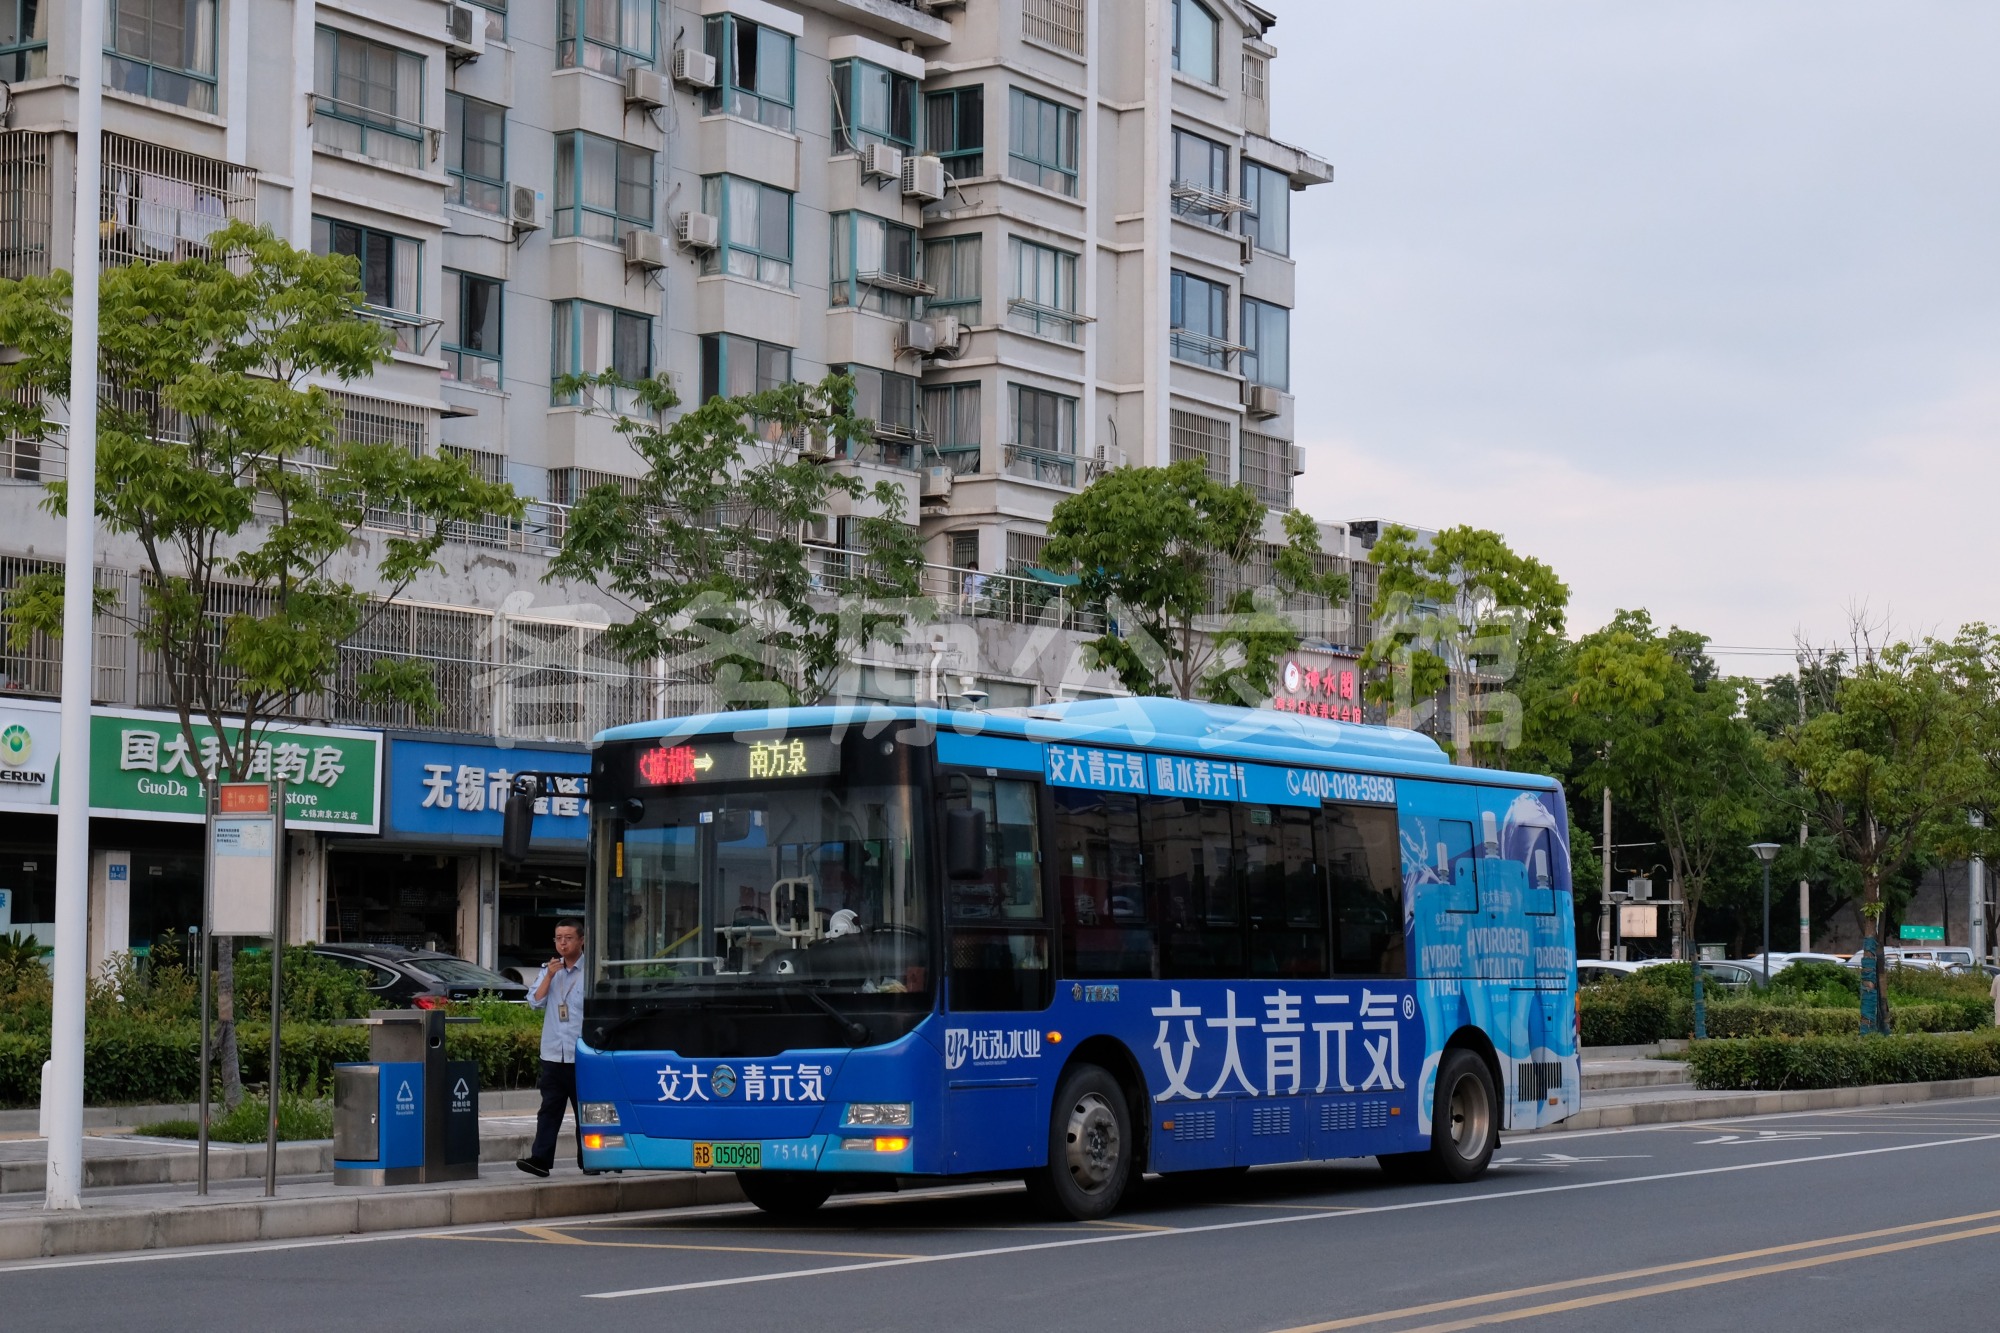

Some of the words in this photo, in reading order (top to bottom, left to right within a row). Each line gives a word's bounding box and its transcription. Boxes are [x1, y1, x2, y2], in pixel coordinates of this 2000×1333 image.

[121, 729, 345, 787] 国大和润药房
[749, 738, 807, 778] 南方泉
[138, 778, 188, 797] GuoDa
[1156, 757, 1247, 798] 喝水养元气
[1302, 771, 1395, 803] 400-018-5958
[1467, 927, 1529, 958] HYDROGEN
[1475, 957, 1524, 988] VITALITY
[657, 1065, 710, 1102] 交大
[773, 1144, 818, 1161] 75141
